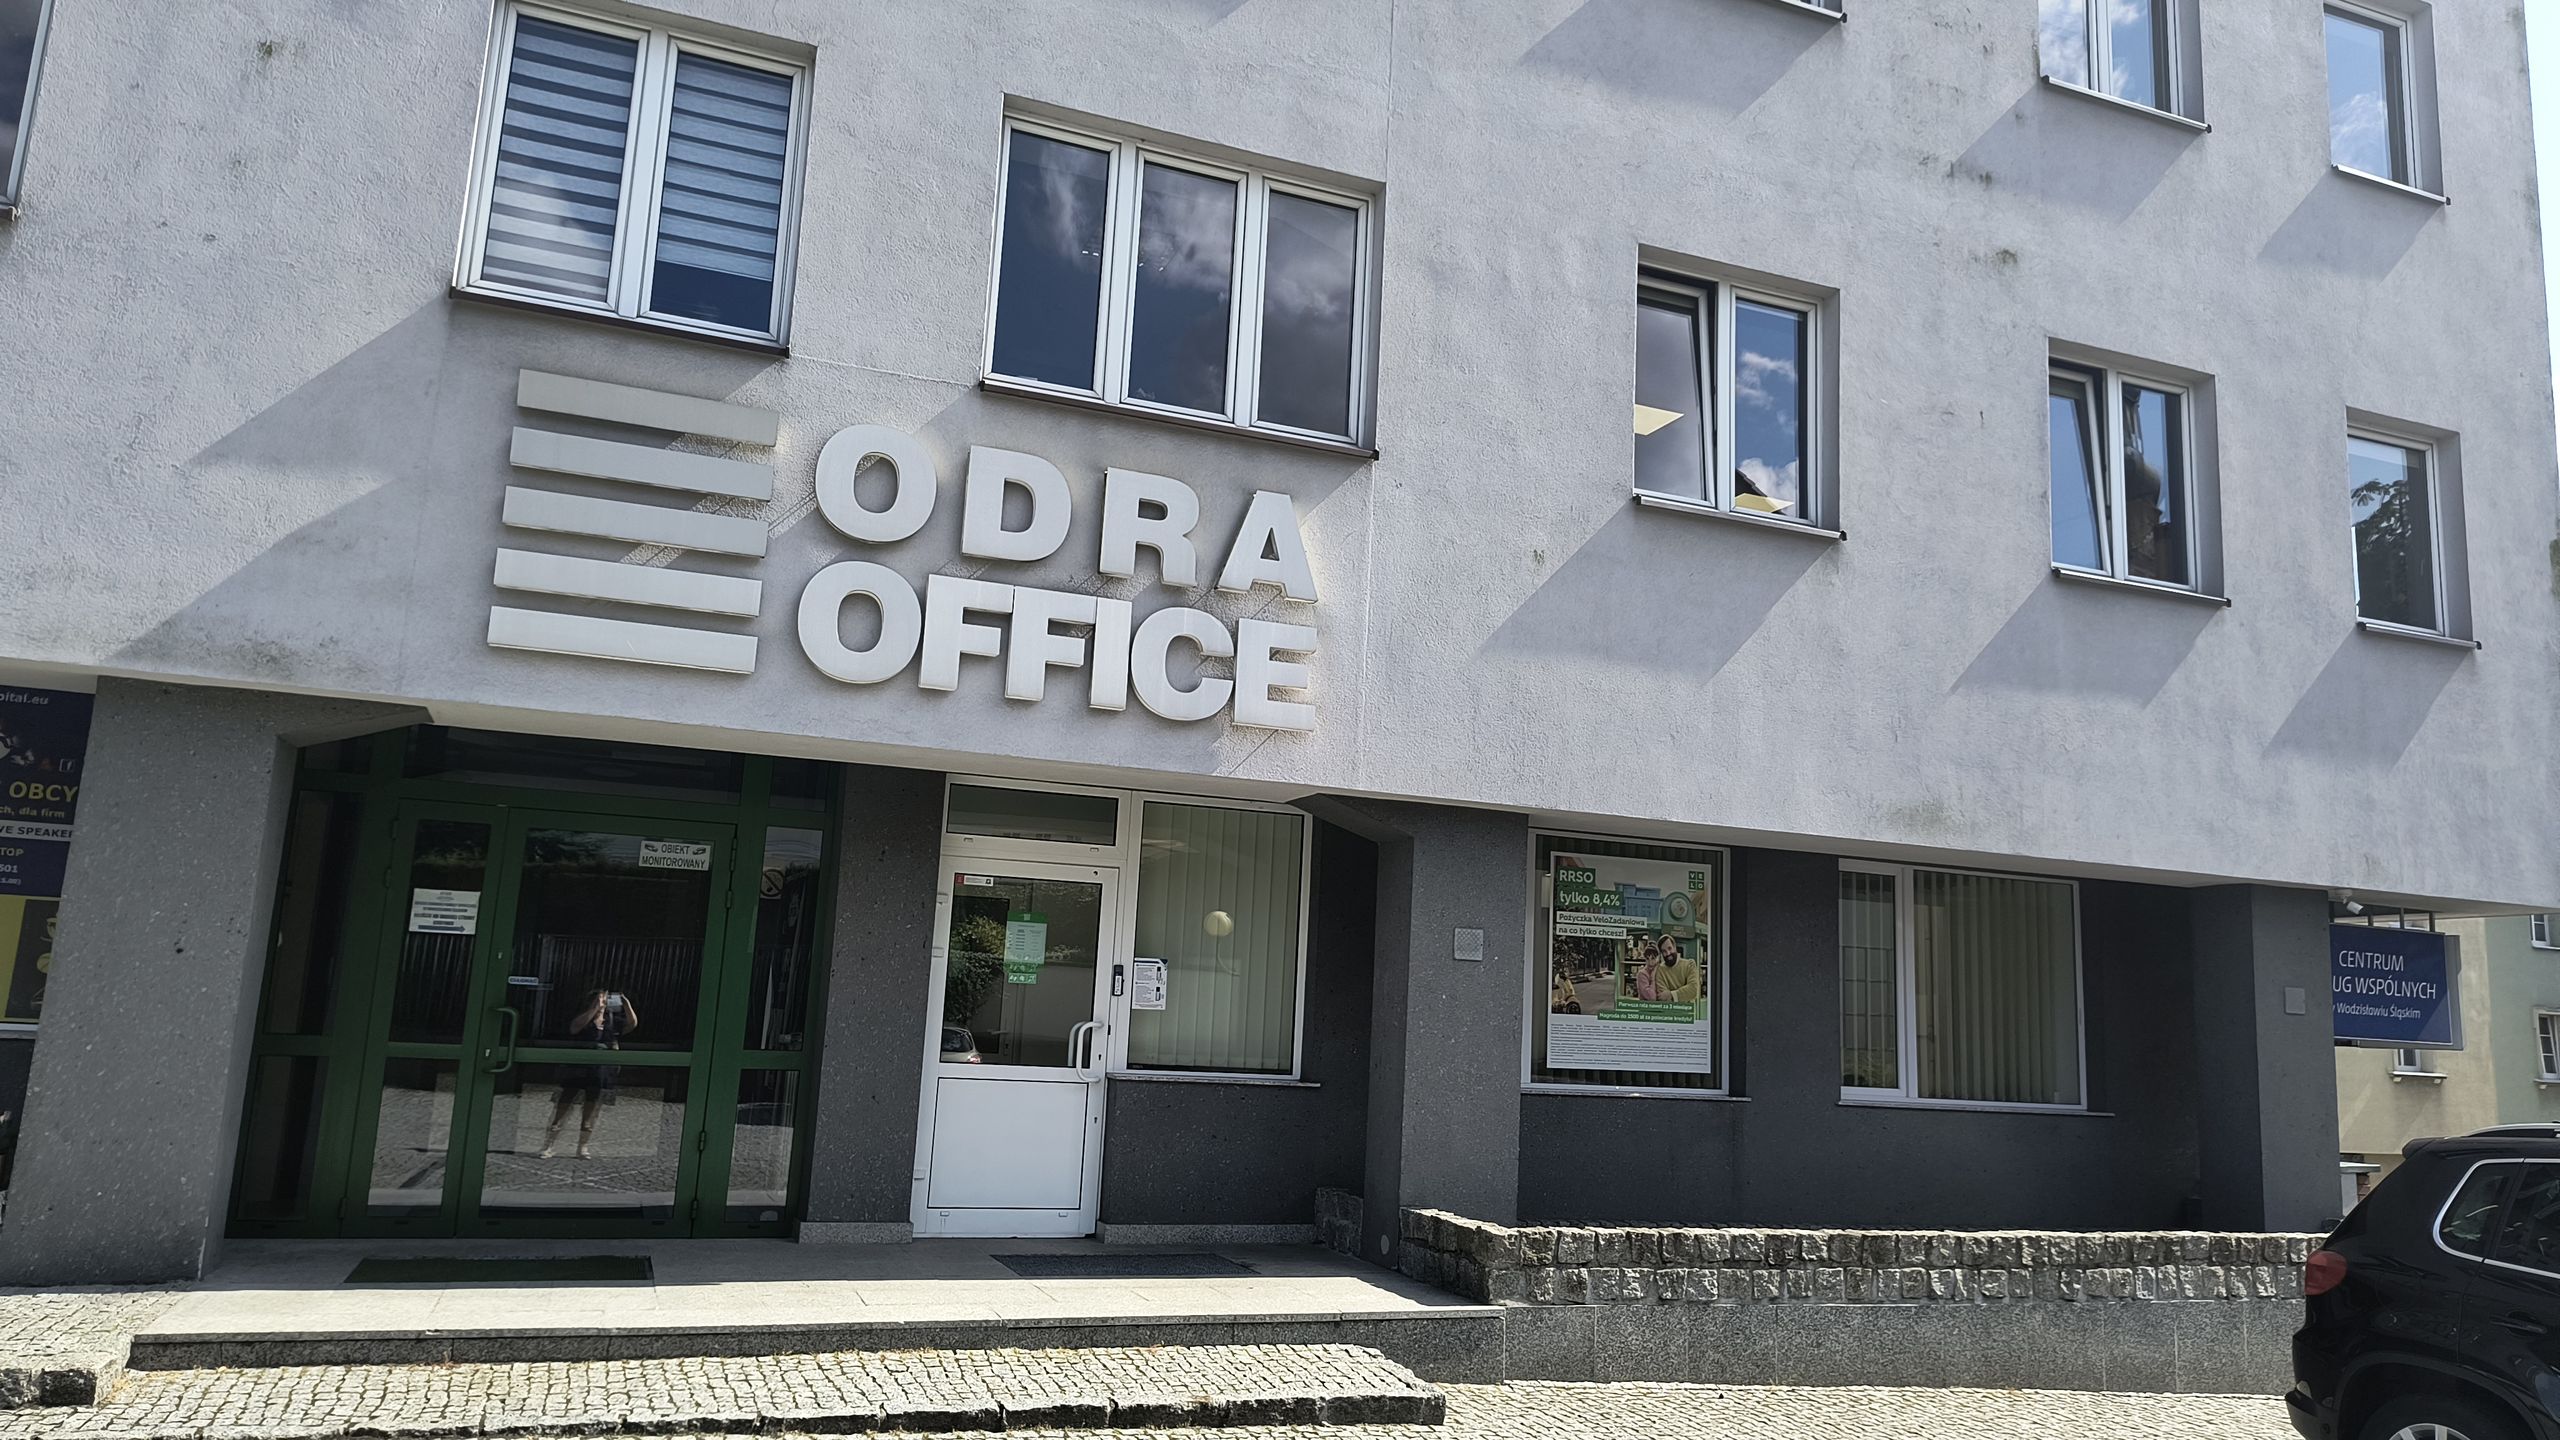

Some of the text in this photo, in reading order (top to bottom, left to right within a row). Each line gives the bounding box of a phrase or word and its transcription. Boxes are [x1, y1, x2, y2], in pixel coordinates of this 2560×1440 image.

[813, 422, 1319, 605] ODRA
[797, 560, 1319, 733] OFFICE
[8, 780, 79, 802] OBCY
[19, 806, 38, 817] dla
[41, 807, 65, 819] firm
[661, 843, 691, 855] OBIEKT
[641, 855, 706, 870] MONITOROWANY
[1559, 869, 1594, 884] RRSO
[1559, 890, 1621, 907] tylko 8,4%
[1559, 912, 1646, 927] Pożyczka VeloZadaniowa
[1568, 927, 1578, 935] co
[1579, 926, 1598, 938] tylko
[1598, 927, 1625, 938] chcesz!
[2338, 950, 2404, 972] CENTRUM
[2355, 974, 2436, 1000] WSPÓLNYCH
[2336, 1002, 2389, 1017] Wodzisławiu
[2389, 1003, 2421, 1021] Śląskim
